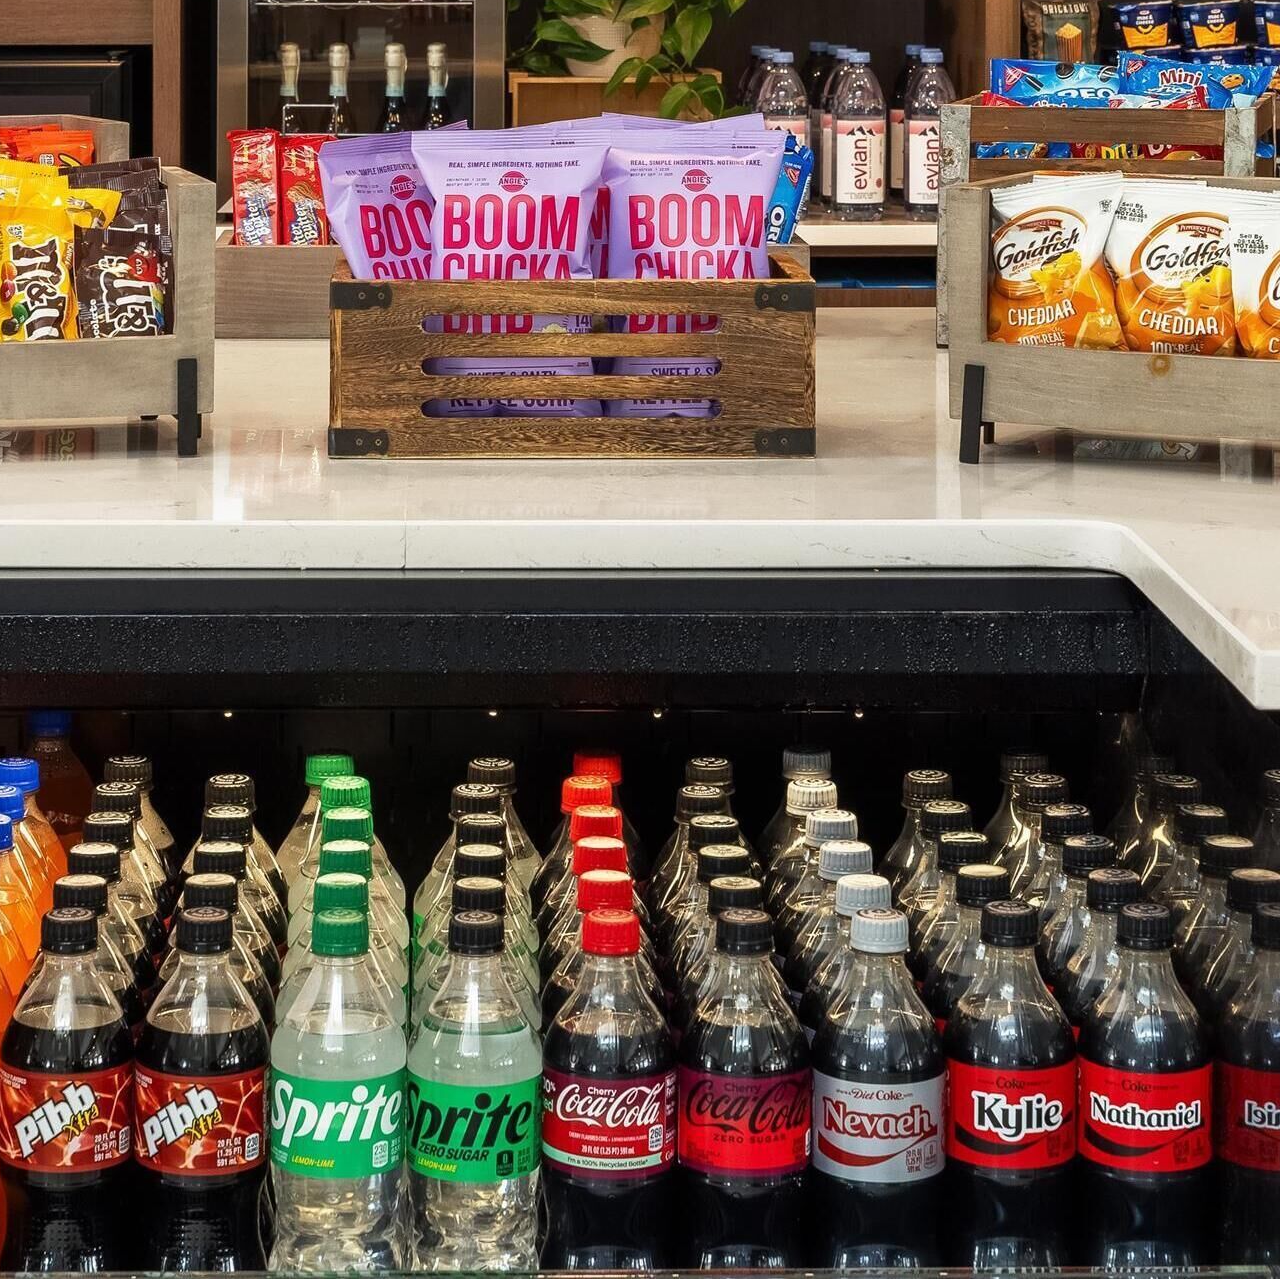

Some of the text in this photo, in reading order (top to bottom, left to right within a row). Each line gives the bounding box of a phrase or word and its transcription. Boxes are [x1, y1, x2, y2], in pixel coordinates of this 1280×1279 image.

[1158, 68, 1203, 87] Mini
[448, 159, 581, 169] REAL, SIMPLE INGREDIENTS. NOTHING FAKE.
[648, 159, 673, 167] SIMPLE
[745, 159, 763, 168] FAKE.
[854, 138, 868, 191] evian
[498, 177, 529, 188] ANGIE'S
[681, 175, 711, 186] ANGIE'S
[443, 194, 580, 252] BOOM
[628, 193, 765, 251] BOOM
[996, 227, 1080, 271] Goldfish
[1007, 298, 1076, 327] CHEDDAR
[1138, 308, 1219, 335] CHEDDAR
[587, 1086, 618, 1099] Cherry
[723, 1082, 762, 1095] Cherry
[995, 1076, 1025, 1090] Coke
[1121, 1078, 1152, 1093] Coke
[852, 1088, 903, 1101] Diet Coke
[272, 1079, 403, 1148] Sprite
[407, 1080, 533, 1150] Sprite
[556, 1082, 666, 1129] Coca-Cola
[686, 1078, 812, 1135] Coca-Cola
[1091, 1094, 1201, 1129] Nathaniel
[15, 1082, 96, 1159] Pibb
[62, 1103, 100, 1142] Xtra
[143, 1084, 218, 1157] Pibb
[823, 1096, 932, 1139] Nevaeh
[974, 1094, 1063, 1139] Kylie
[185, 1109, 223, 1144] Xtra
[650, 1127, 662, 1139] 260
[246, 1138, 259, 1149] 230
[713, 1133, 786, 1144] ZERO SUGAR
[373, 1143, 387, 1156] 230
[419, 1143, 489, 1162] ZERO SUGAR
[291, 1154, 336, 1169] LEMON-LIME
[417, 1157, 458, 1173] LEMON-LIME
[567, 1156, 576, 1164] I'm
[581, 1158, 598, 1167] 100%
[598, 1159, 626, 1169] Recycled
